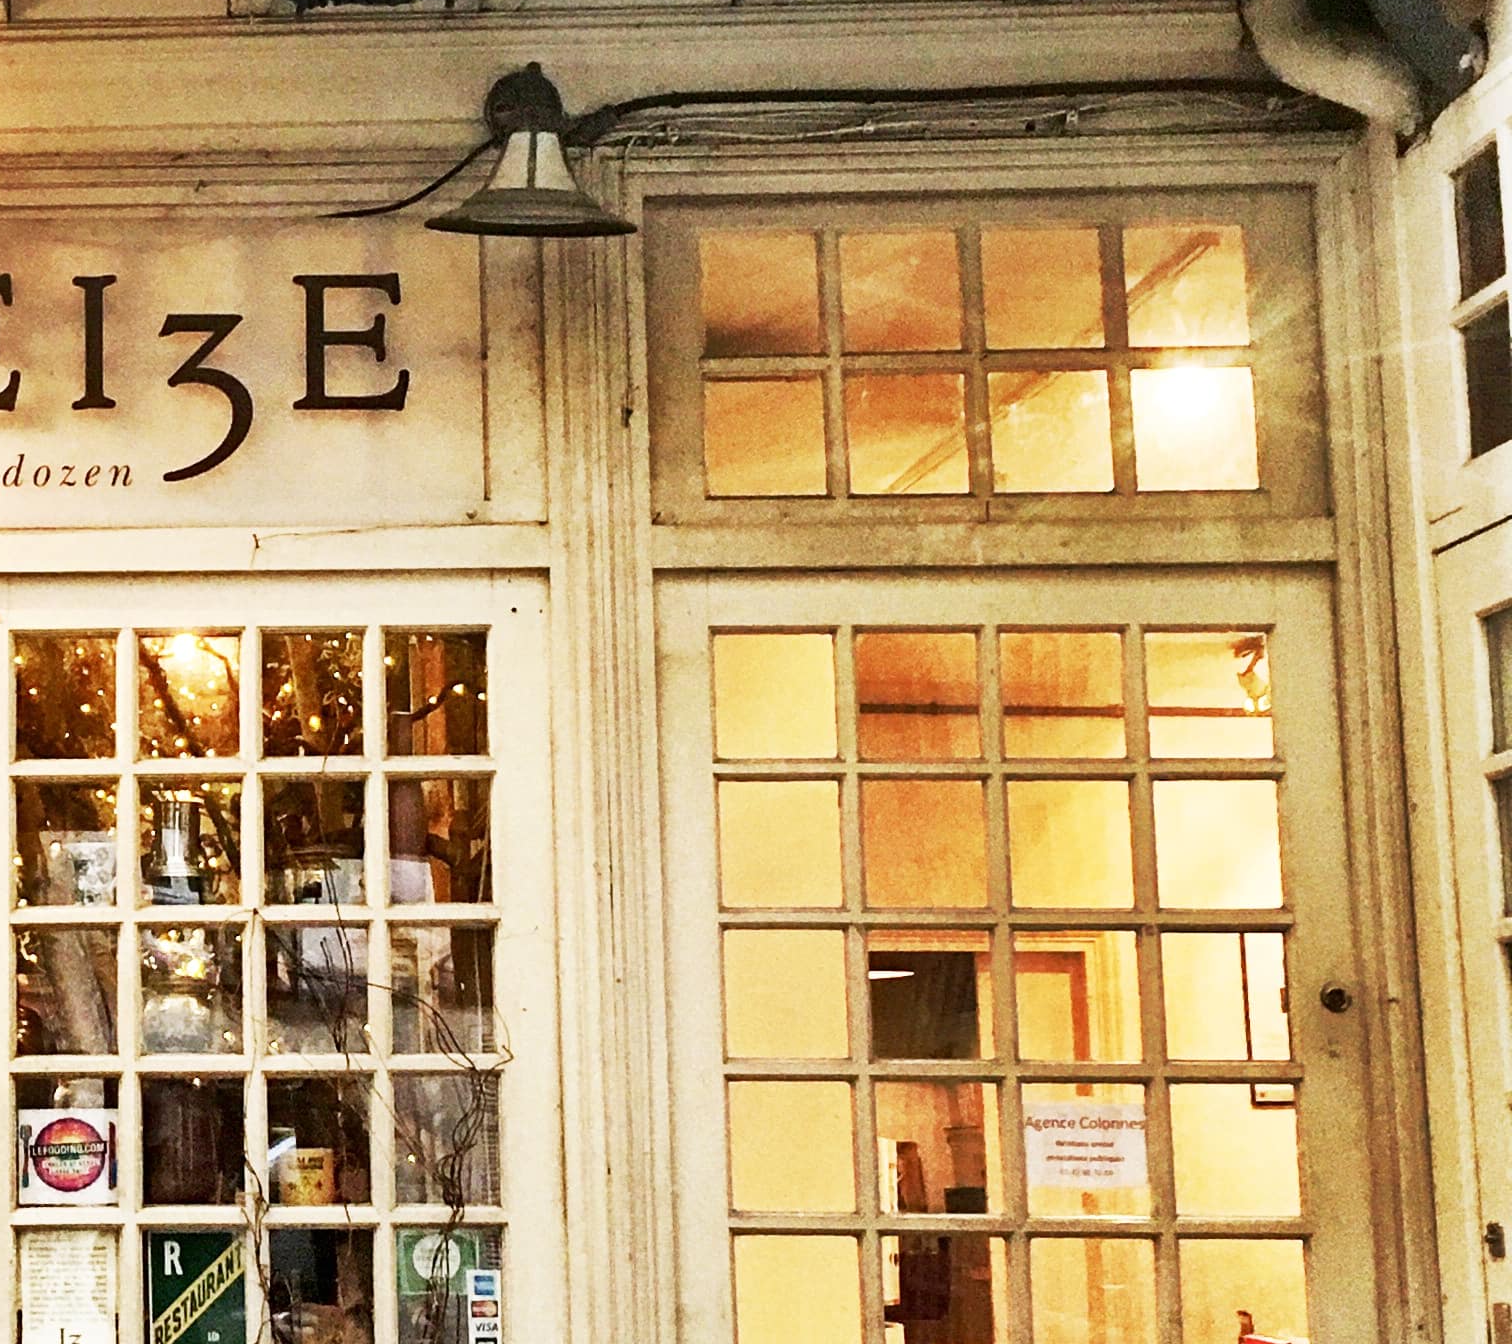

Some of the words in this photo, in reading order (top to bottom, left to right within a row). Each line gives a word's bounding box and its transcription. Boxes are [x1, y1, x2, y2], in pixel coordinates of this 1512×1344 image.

[1, 452, 135, 488] dozen
[1024, 1116, 1076, 1132] Agence
[1079, 1115, 1145, 1130] Colonnes
[163, 1240, 184, 1276] R
[475, 1322, 499, 1332] VISA
